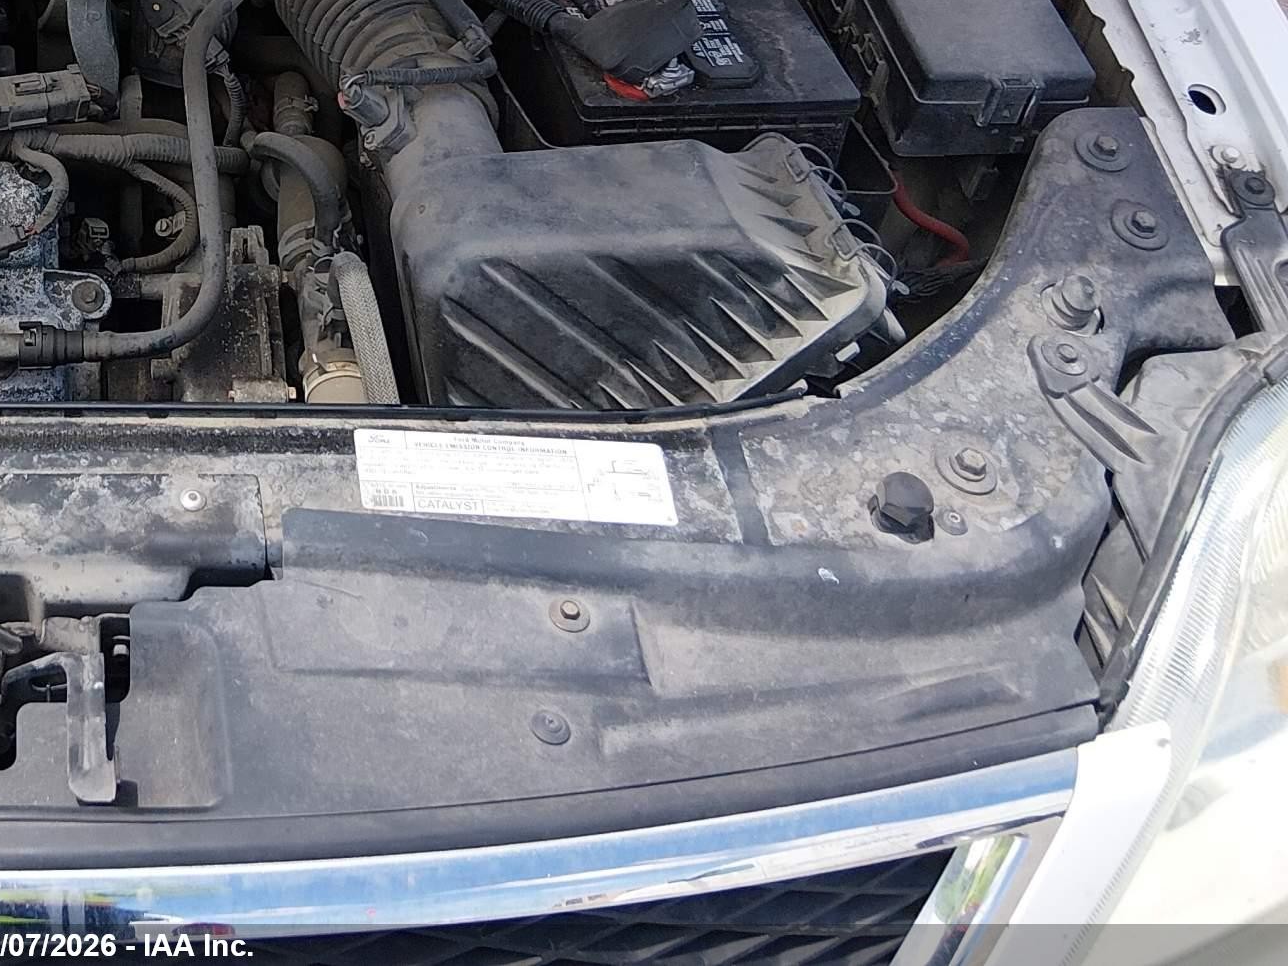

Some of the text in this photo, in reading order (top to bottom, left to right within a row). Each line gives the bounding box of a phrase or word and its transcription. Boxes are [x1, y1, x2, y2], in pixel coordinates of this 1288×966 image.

[445, 443, 480, 451] EMISSION
[518, 446, 567, 455] INFORMATION
[417, 498, 479, 512] CATALYST
